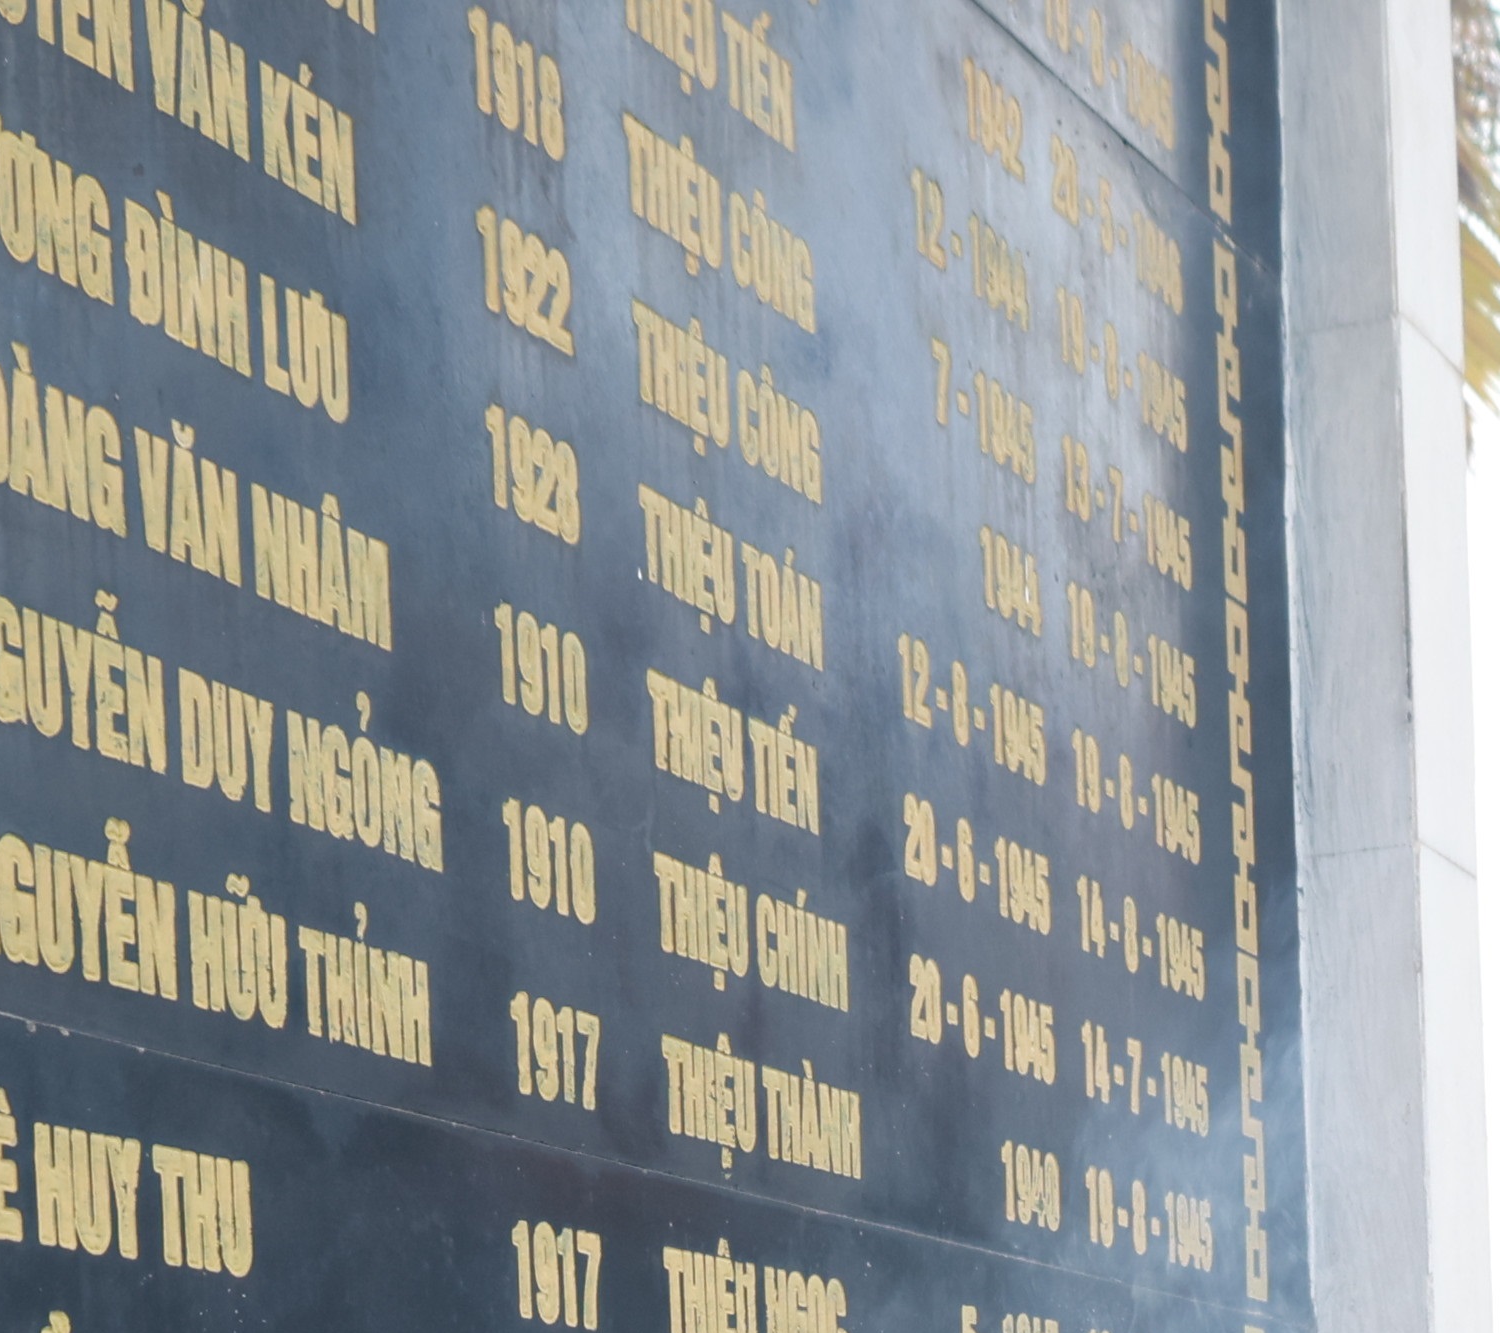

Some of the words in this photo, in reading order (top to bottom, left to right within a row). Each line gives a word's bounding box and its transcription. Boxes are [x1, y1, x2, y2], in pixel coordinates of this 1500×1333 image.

[259, 62, 358, 226] KÉN
[476, 205, 574, 357] 1922
[631, 296, 730, 457] THIỆU
[737, 364, 822, 504] CÔNG
[468, 5, 565, 161] 1918
[622, 111, 722, 276] THIỆU
[729, 188, 816, 334] CÔNG
[125, 190, 252, 378] ĐÌNH
[260, 275, 349, 424] LƯU
[485, 403, 580, 545] 1928
[638, 483, 735, 634] THIỆU
[741, 547, 824, 672] TOÁN
[134, 419, 241, 587] VĂN
[251, 483, 392, 651] NHÂM
[493, 601, 589, 735] 1910
[646, 667, 744, 814] THIỆU
[748, 704, 819, 836] TIẾN
[179, 667, 273, 813] DUY
[287, 690, 444, 873] NGỎNG
[502, 797, 596, 925] 1910
[653, 852, 749, 991] THIỆU
[756, 888, 849, 1012] CHÍNH
[33, 1121, 140, 1260] HUY
[152, 1143, 254, 1278] THU
[511, 1219, 602, 1330] 1917
[188, 873, 288, 1029] HỮU
[298, 902, 432, 1067] THỈNH
[510, 990, 600, 1111] 1917
[661, 1033, 757, 1170] THIỆU
[762, 1058, 862, 1180] THÀNH
[1001, 1139, 1061, 1232] 1940
